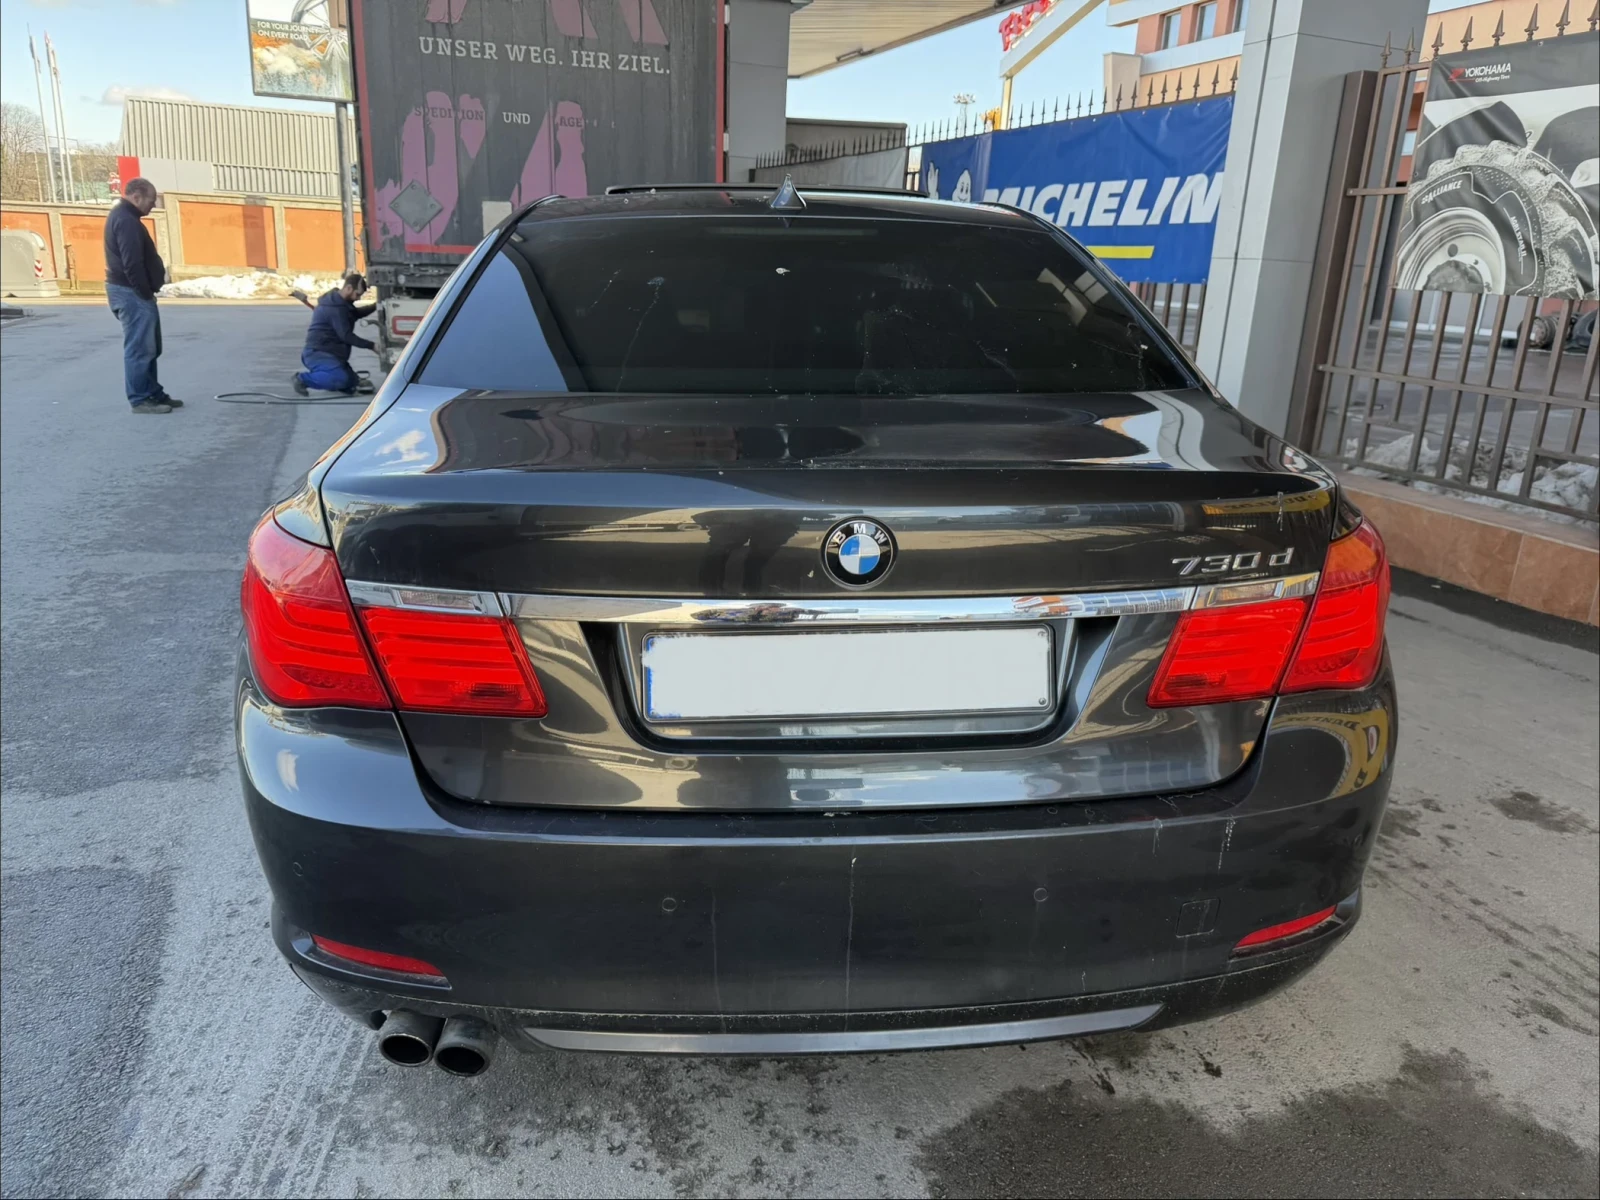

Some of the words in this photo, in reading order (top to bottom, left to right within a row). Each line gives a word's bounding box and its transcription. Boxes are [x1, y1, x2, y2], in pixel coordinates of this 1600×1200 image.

[271, 31, 288, 39] EVERY
[290, 33, 307, 41] ROAD
[418, 35, 498, 60] UNSER
[505, 43, 564, 66] WEG.
[571, 50, 611, 70] IHR
[617, 53, 671, 75] ZIEL.
[1464, 62, 1512, 78] YOKOHAMA
[413, 105, 485, 121] SPEDIION
[502, 111, 531, 125] UND
[1427, 179, 1463, 203] ALLIANCE
[833, 523, 887, 544] BMW
[1172, 552, 1261, 576] 730
[1269, 547, 1294, 567] d
